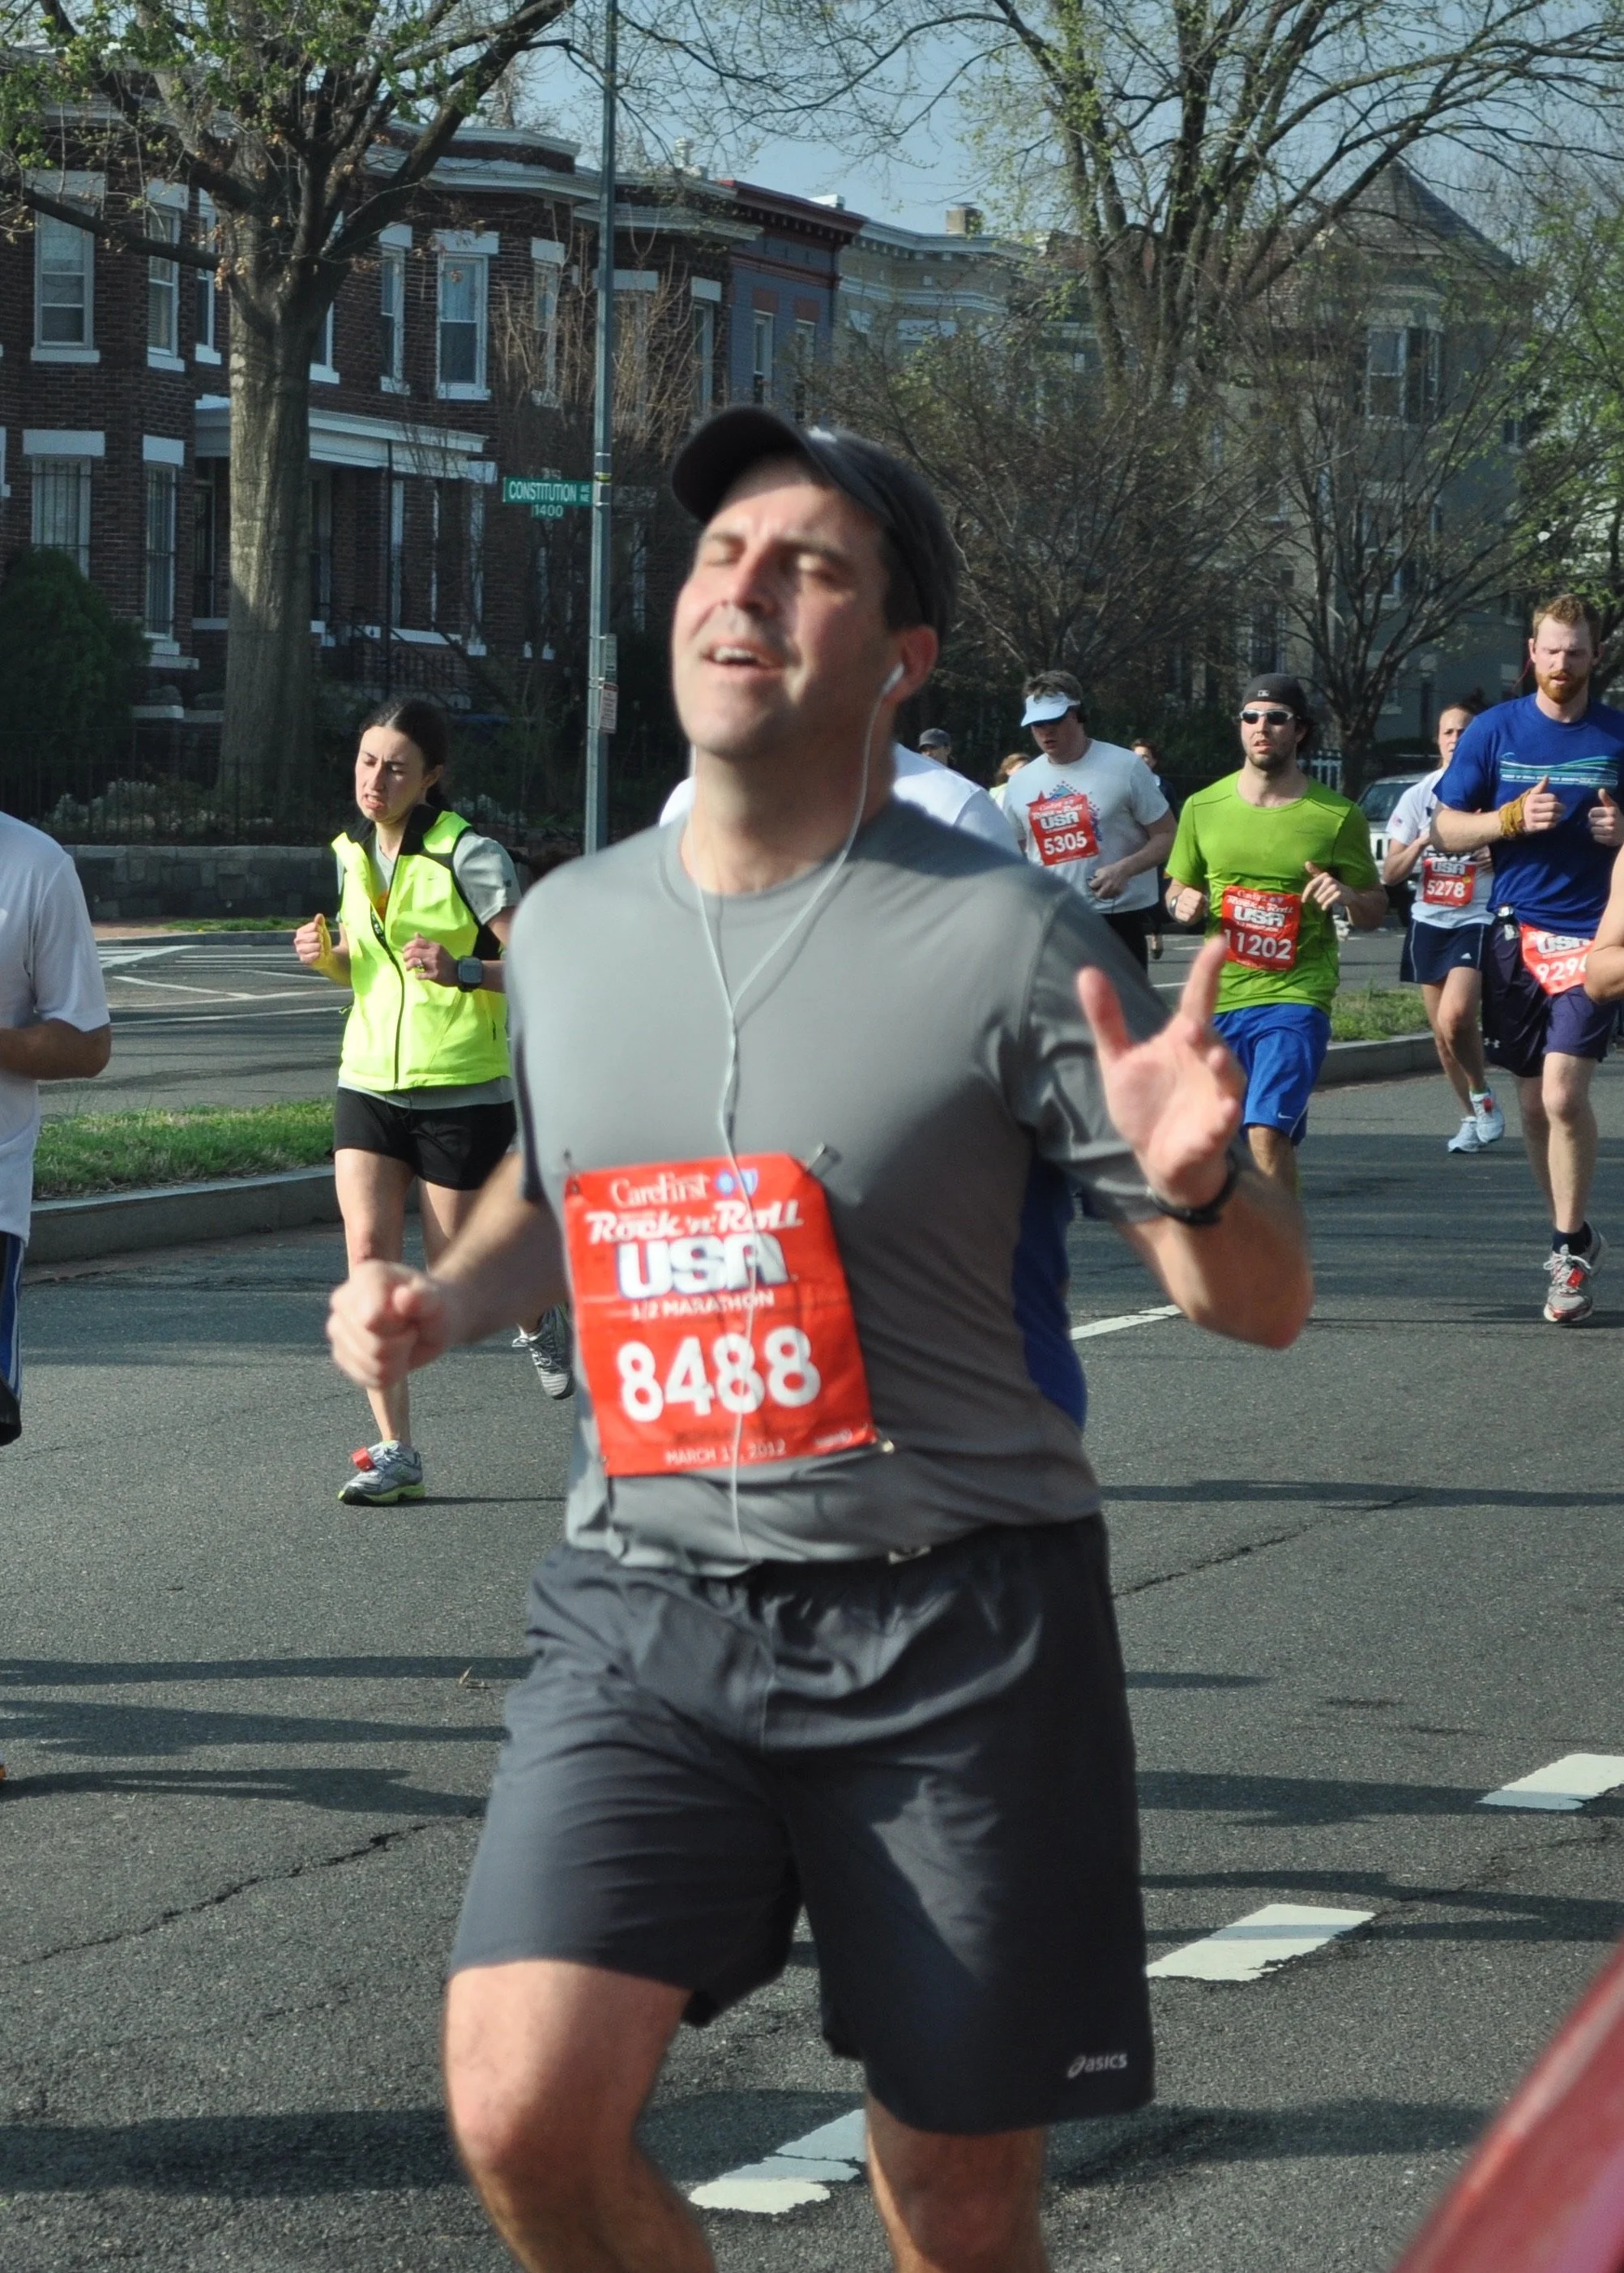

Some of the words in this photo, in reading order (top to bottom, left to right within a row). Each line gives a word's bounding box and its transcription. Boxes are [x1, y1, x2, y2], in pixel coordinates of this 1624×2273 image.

[509, 481, 576, 502] CONSTITUTION
[535, 504, 563, 517] 1400
[1040, 811, 1079, 830] USA
[1044, 831, 1088, 855] 5305
[1431, 861, 1466, 875] USA
[1426, 879, 1465, 898] 5278
[1233, 905, 1285, 927] USA
[1224, 929, 1292, 959] 11202
[610, 1171, 710, 1208] CareFirst
[583, 1210, 685, 1244] Rock
[617, 1232, 789, 1300] USA
[630, 1300, 659, 1321] 1/2
[661, 1290, 776, 1318] MARATHON
[617, 1326, 822, 1422] 8488
[665, 1446, 717, 1466] MARCH
[750, 1438, 786, 1459] 2012
